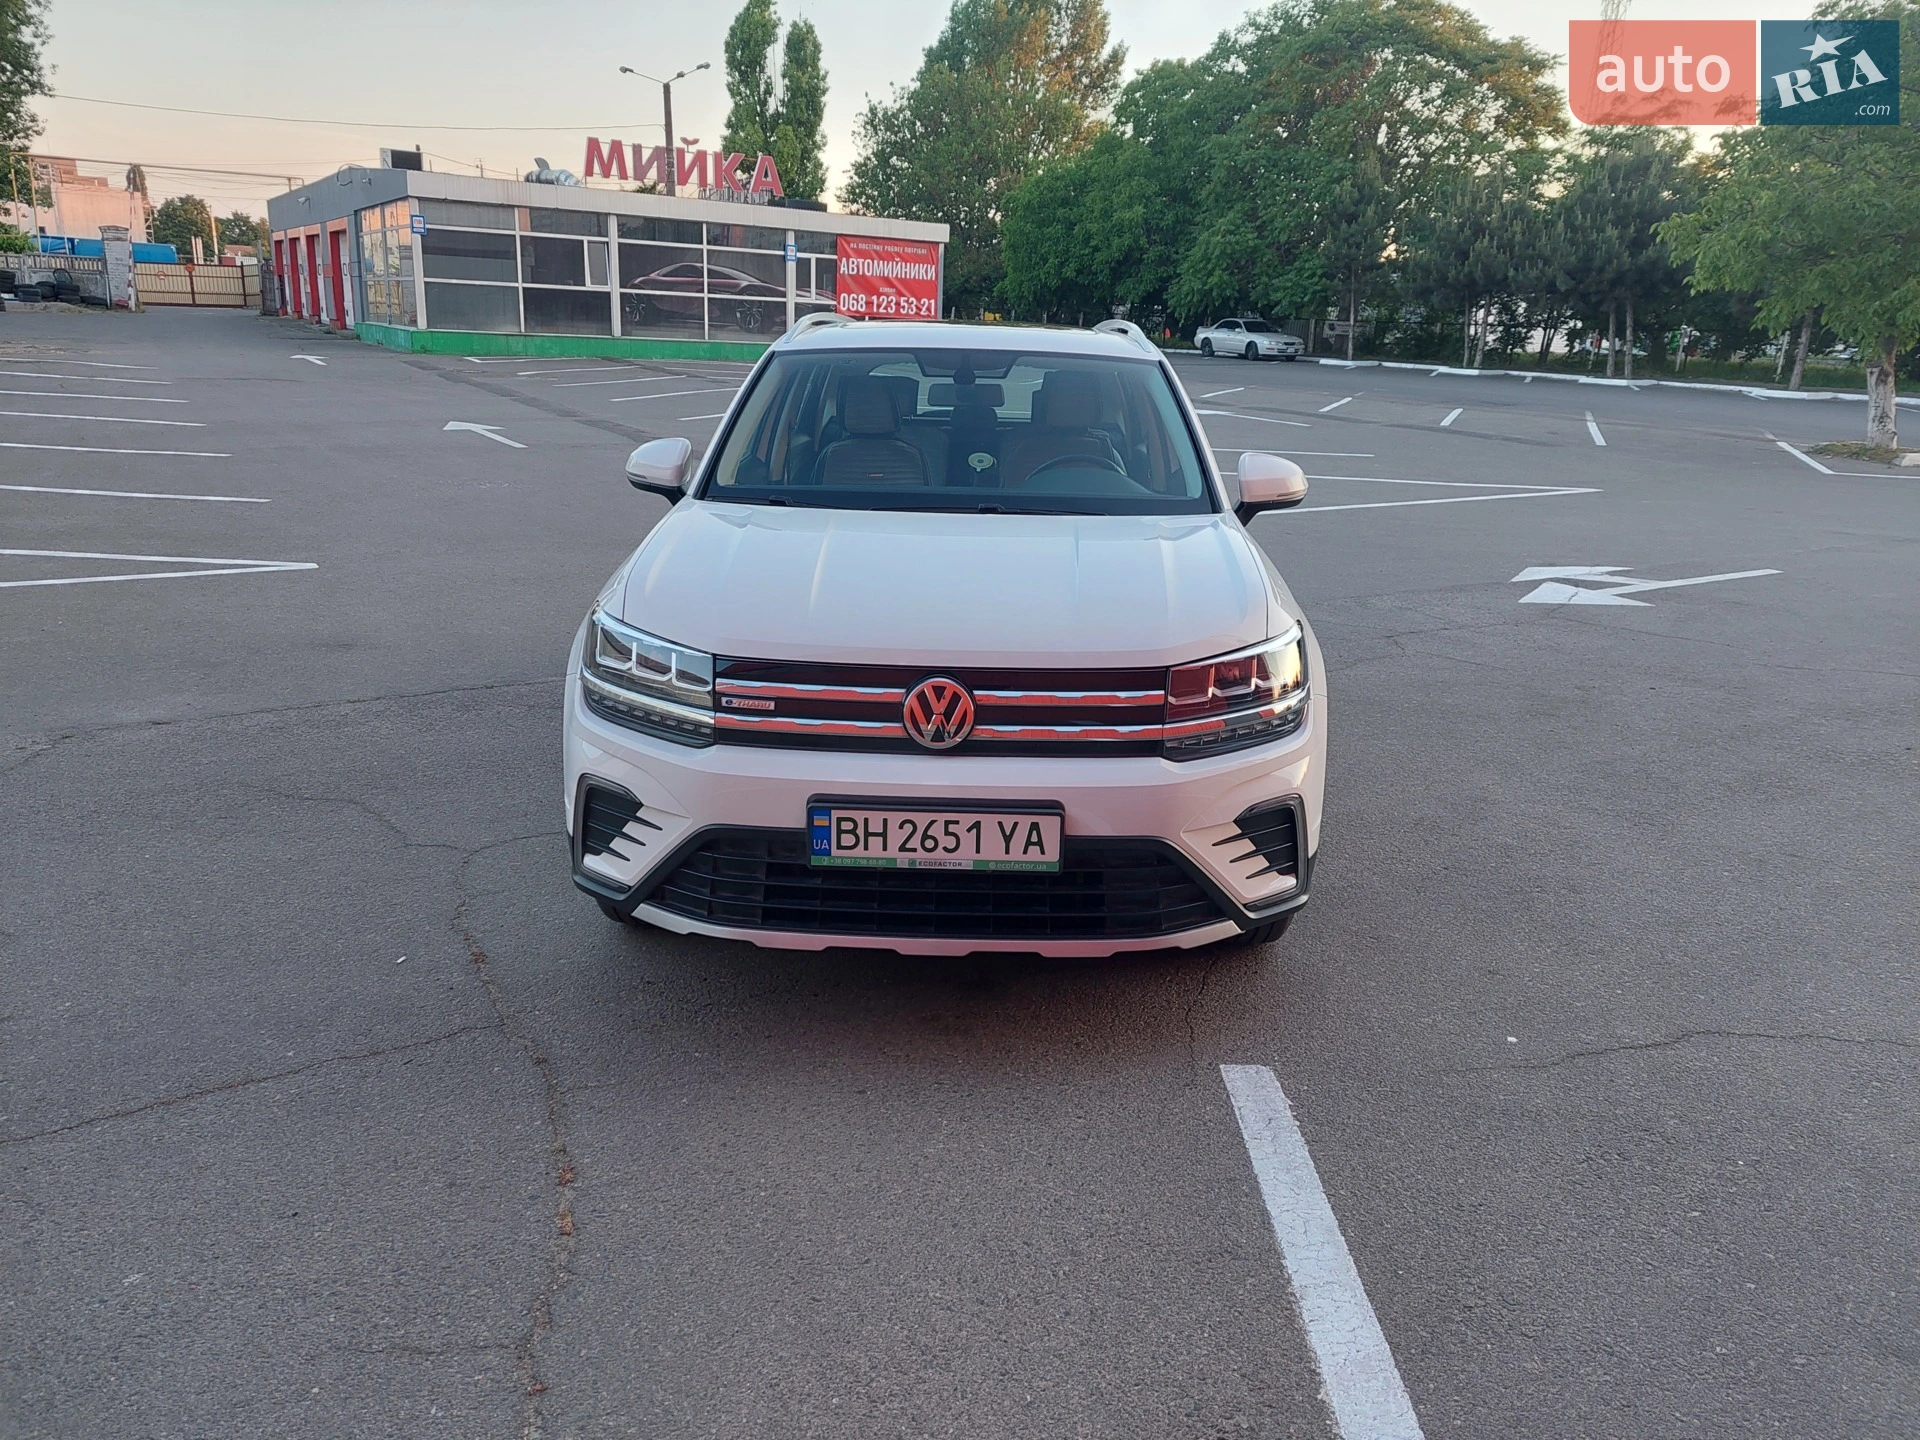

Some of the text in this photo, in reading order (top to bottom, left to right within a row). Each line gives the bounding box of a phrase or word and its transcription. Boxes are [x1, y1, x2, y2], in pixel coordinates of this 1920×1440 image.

[584, 136, 783, 197] МИЙКА
[840, 257, 936, 280] АВТОМИЙНИКИ
[840, 293, 935, 316] 068 123 53 21
[813, 838, 830, 850] UA
[835, 816, 1046, 856] BH 2651 YA
